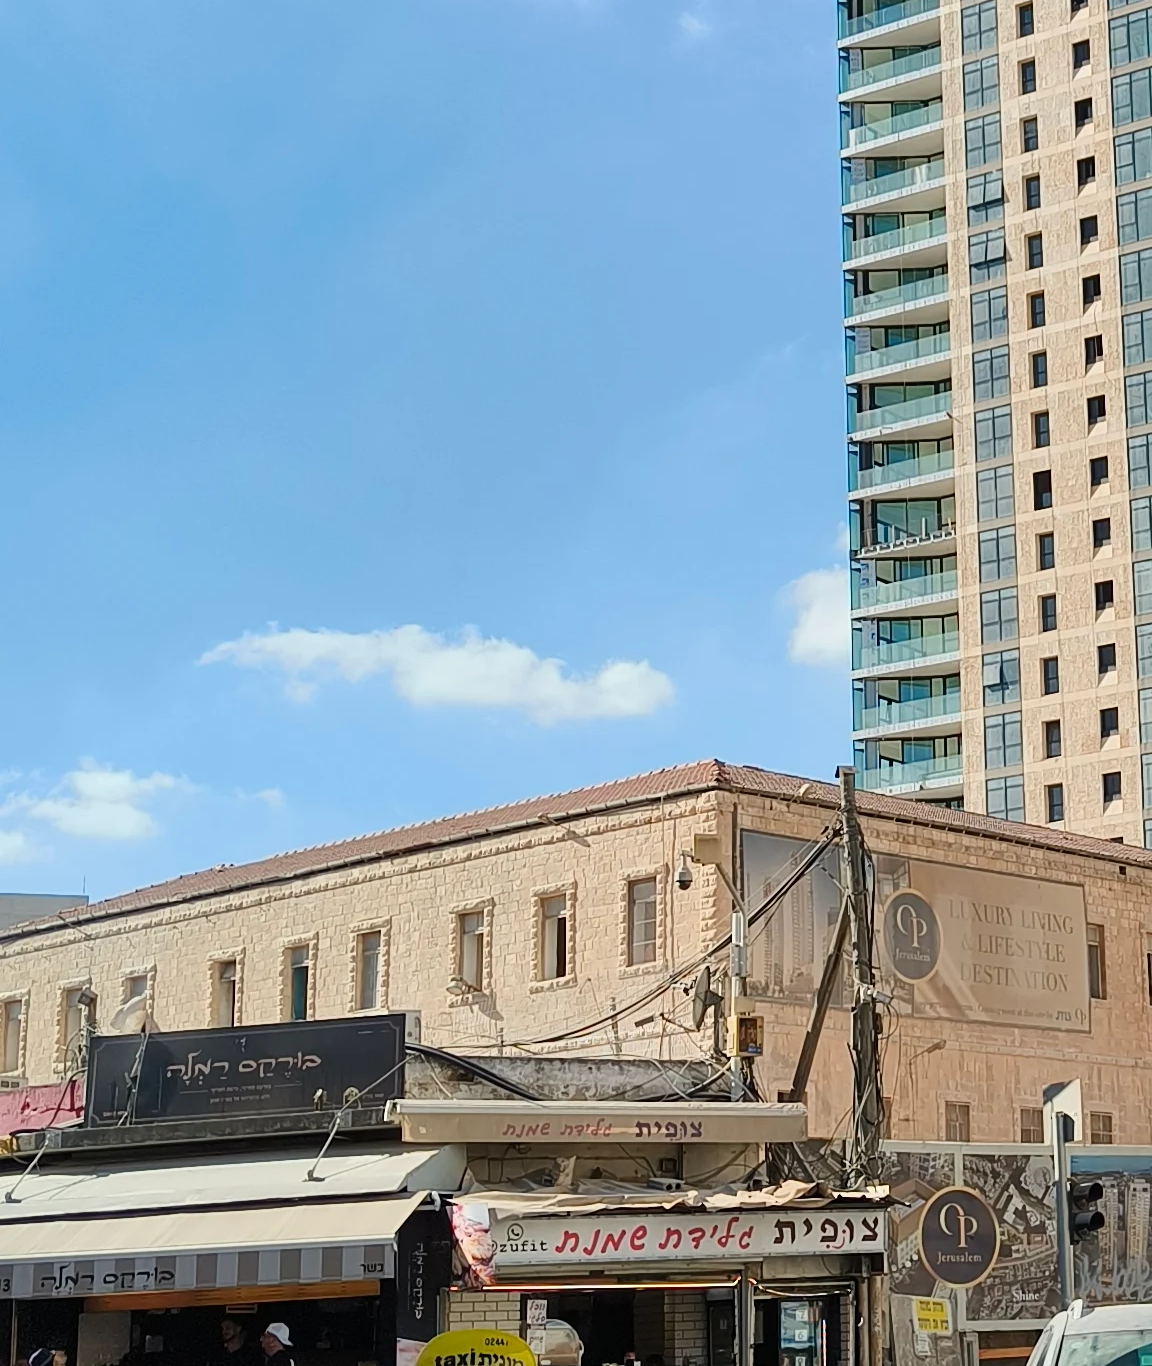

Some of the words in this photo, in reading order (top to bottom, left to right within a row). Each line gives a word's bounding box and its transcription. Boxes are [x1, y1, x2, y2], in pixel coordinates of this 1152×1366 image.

[948, 899, 1014, 926] LUXURY
[1021, 909, 1074, 935] LIVING
[894, 948, 931, 962] Jerusalem
[977, 934, 1066, 963] LIFESTYLE
[960, 963, 1068, 993] DESTINATION
[502, 1122, 551, 1138] שמנת
[559, 1118, 613, 1137] גלידת
[554, 1225, 647, 1257] שמנת
[658, 1216, 754, 1251] גלידת
[936, 1251, 982, 1264] Jerusalem
[360, 1262, 384, 1273] כשר
[1012, 1289, 1041, 1302] Shine
